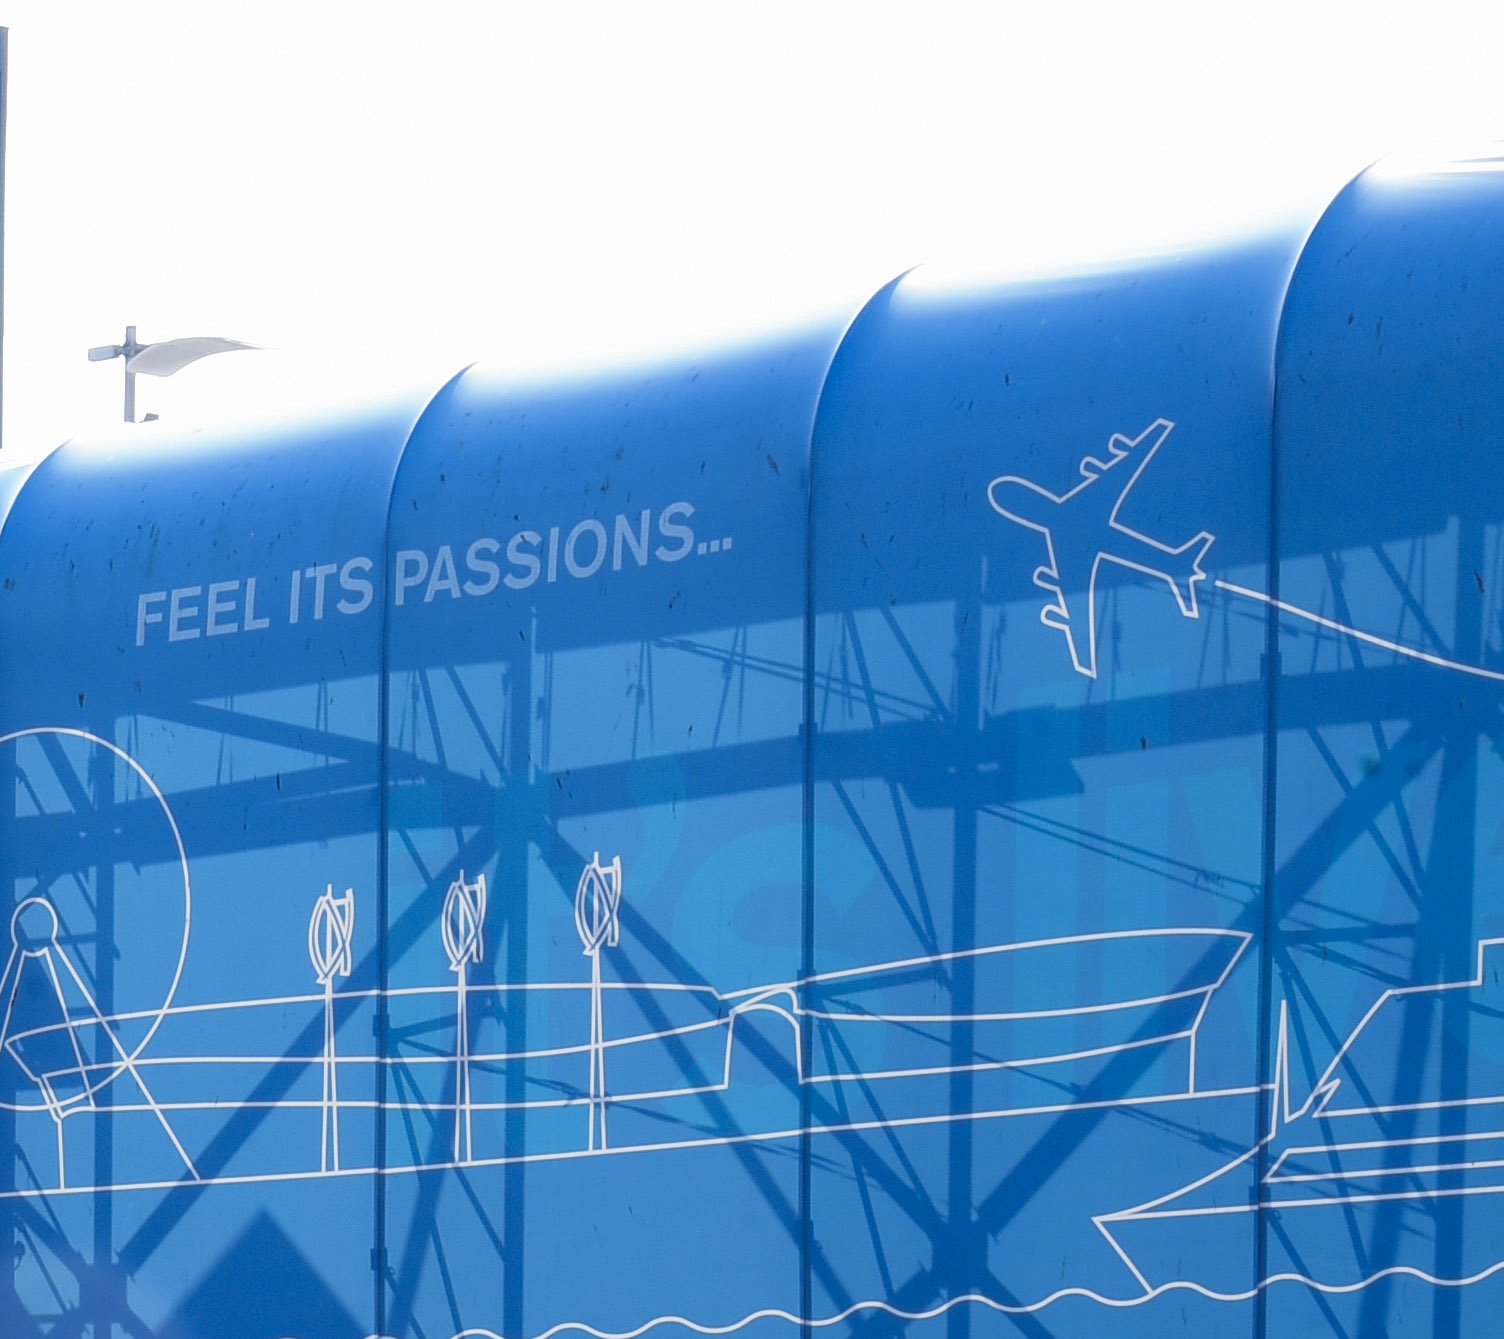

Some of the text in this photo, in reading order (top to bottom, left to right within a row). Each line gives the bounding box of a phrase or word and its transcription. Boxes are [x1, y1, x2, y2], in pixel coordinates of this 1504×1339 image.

[136, 498, 735, 649] FEEL ITS PASSIONS...
